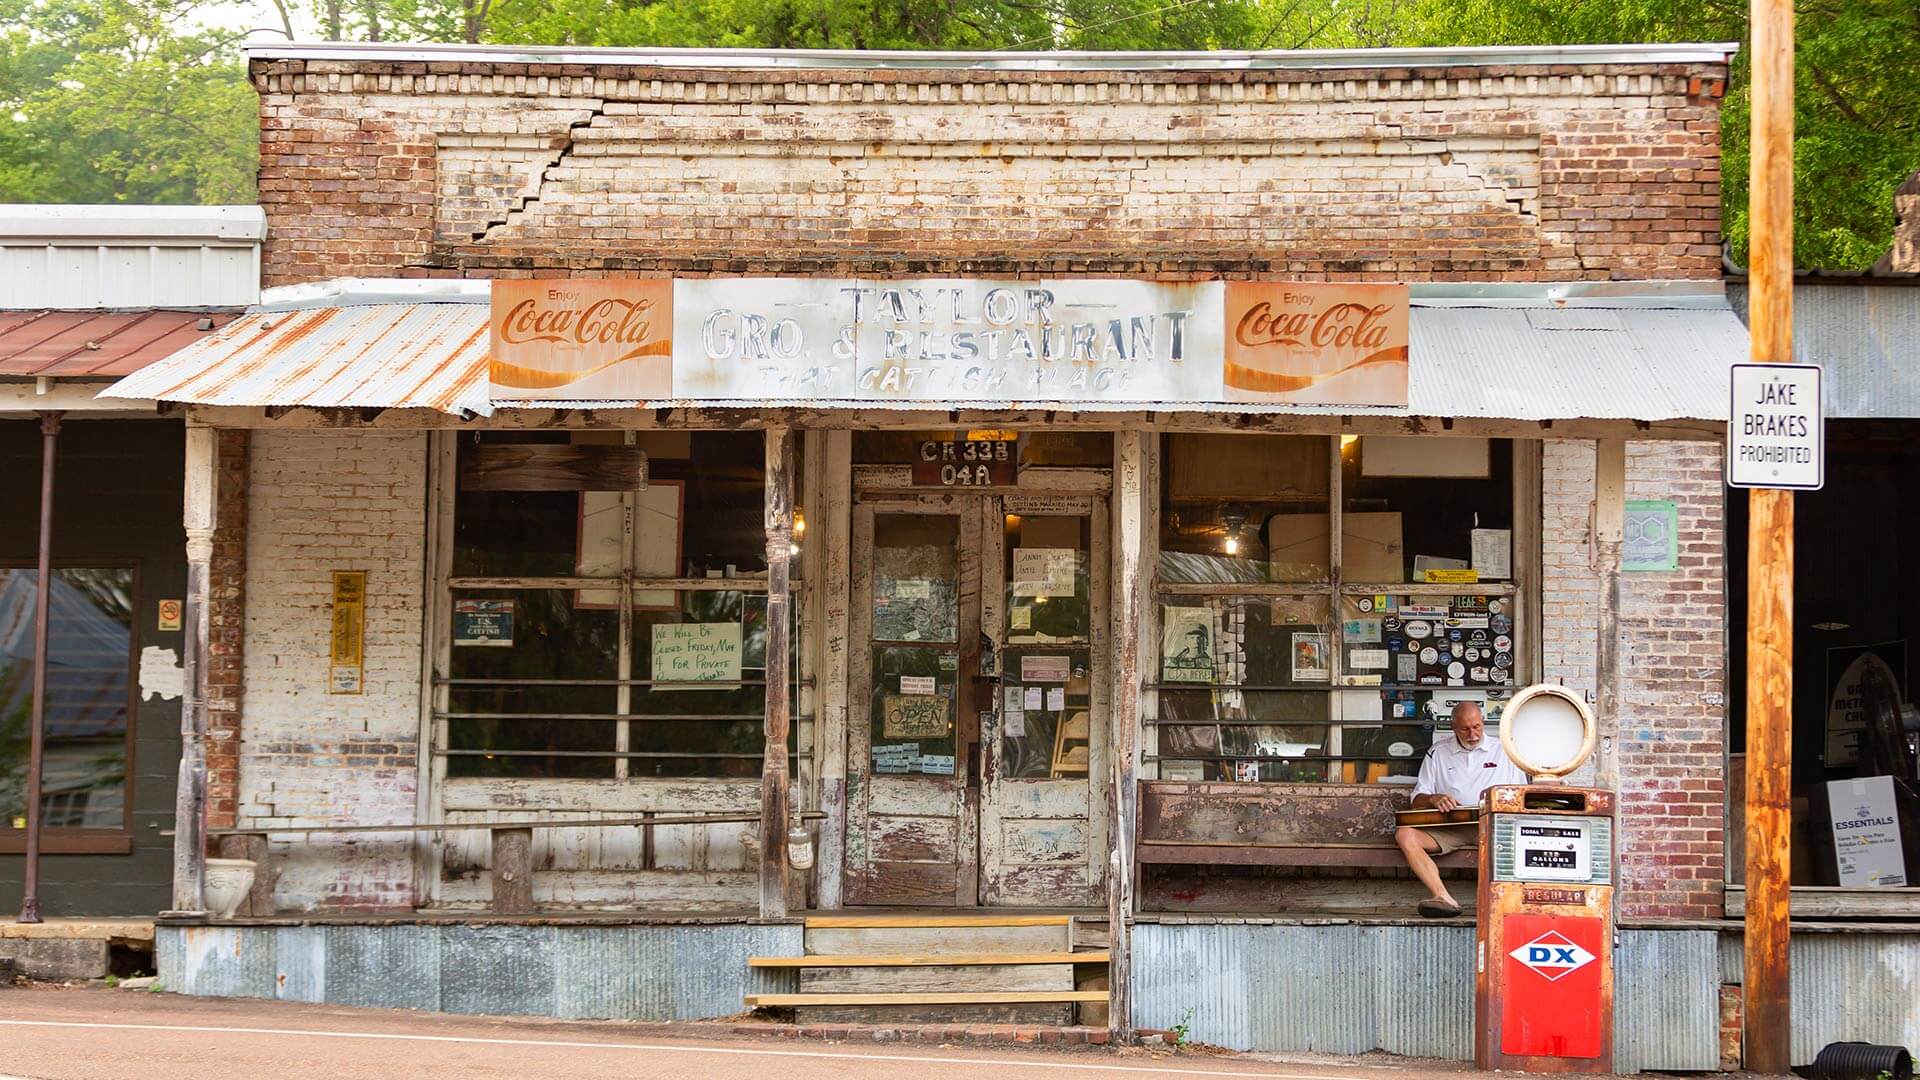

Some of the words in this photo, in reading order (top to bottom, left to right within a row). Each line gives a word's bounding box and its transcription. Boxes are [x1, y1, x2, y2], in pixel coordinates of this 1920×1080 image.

[548, 289, 580, 303] Enjoy
[1283, 292, 1315, 305] Enjoy
[841, 288, 1056, 325] TAYLOR
[501, 298, 656, 345] Coca-Cola
[1235, 301, 1395, 348] Coca-Cola
[831, 325, 857, 360] &
[884, 310, 1196, 363] RESTAURANT
[1755, 384, 1797, 406] JAKE
[1744, 414, 1808, 438] BRAKES
[921, 441, 957, 462] CR
[963, 441, 1009, 461] 338
[1740, 445, 1812, 464] PROHIBITED
[941, 464, 991, 486] 04A
[655, 656, 663, 671] 4
[673, 656, 689, 669] FOR
[696, 654, 729, 669] PRIVATE
[889, 708, 943, 725] OPEN
[1835, 816, 1895, 831] ESSENTIALS
[1528, 890, 1581, 903] REGULAR
[1528, 946, 1577, 964] DX
